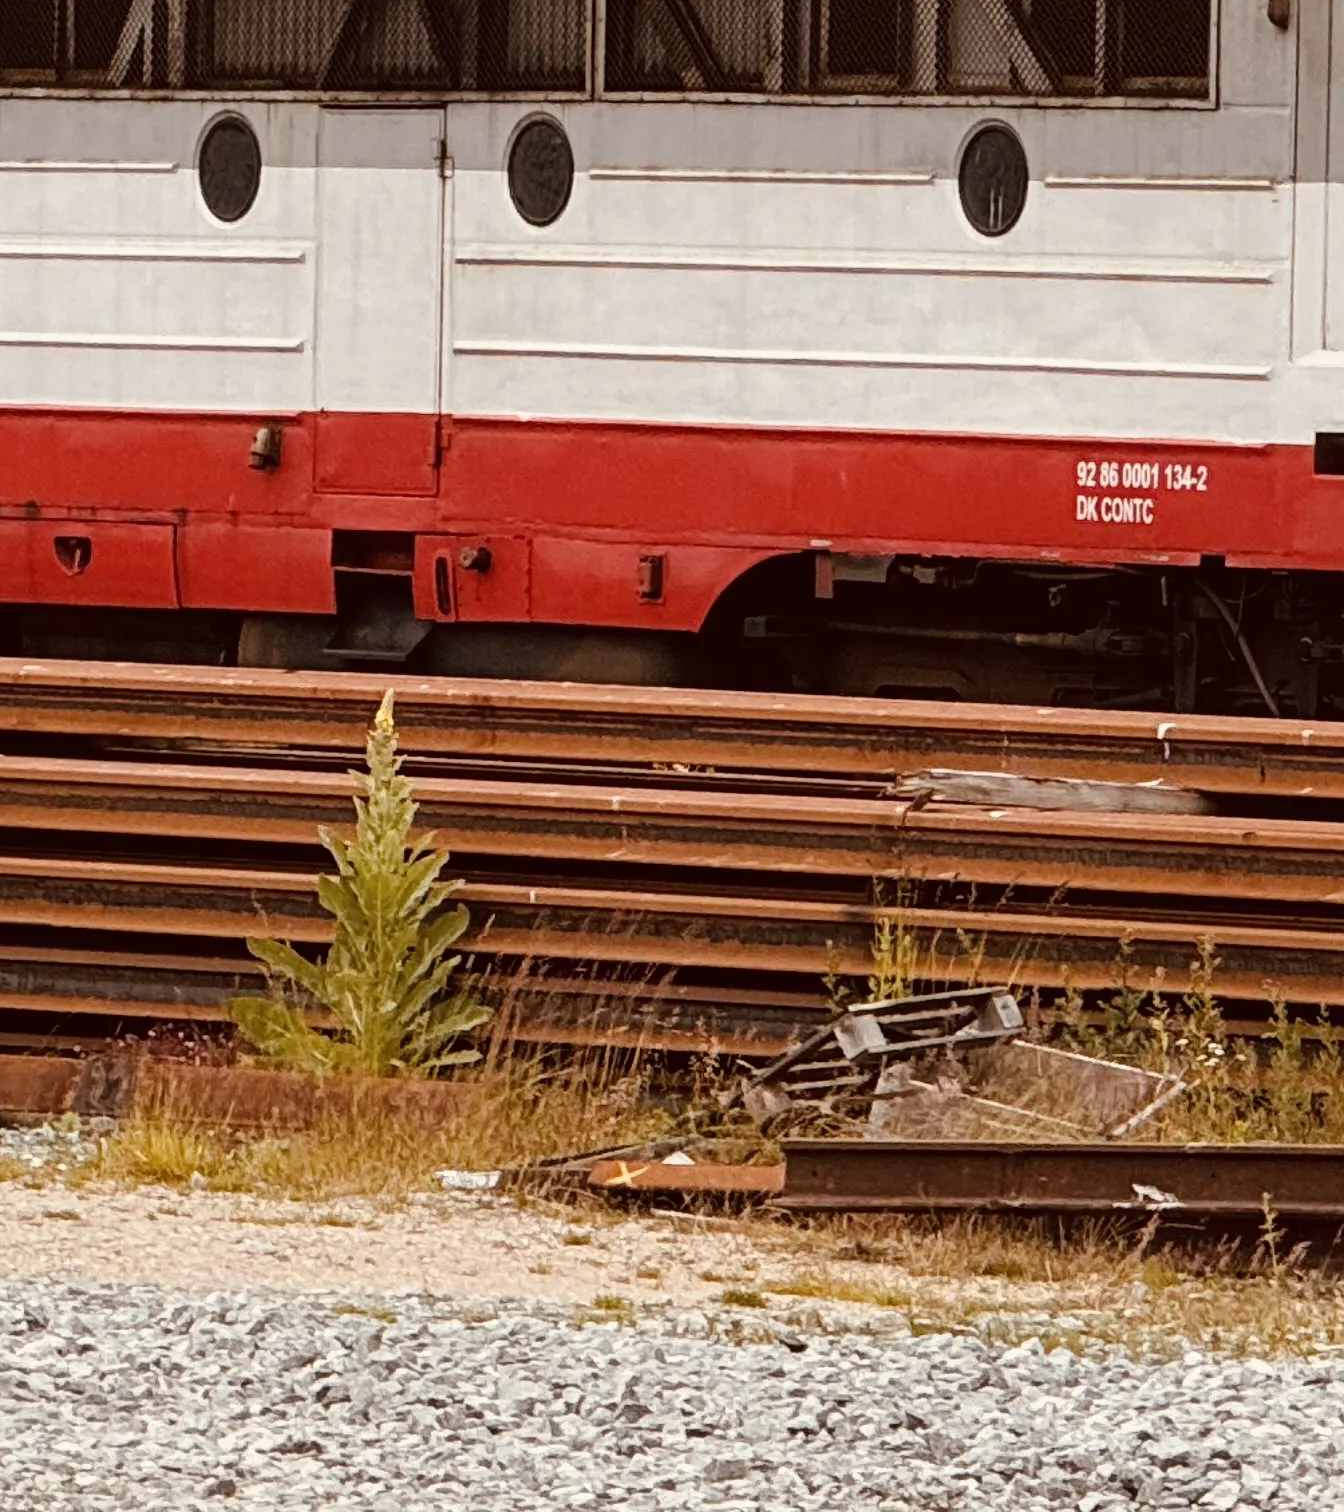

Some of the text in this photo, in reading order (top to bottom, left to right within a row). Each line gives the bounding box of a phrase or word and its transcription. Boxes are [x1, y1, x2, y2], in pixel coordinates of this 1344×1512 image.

[1077, 461, 1208, 491] 92 86 0001 134-2
[1076, 495, 1154, 524] DK CONTC
